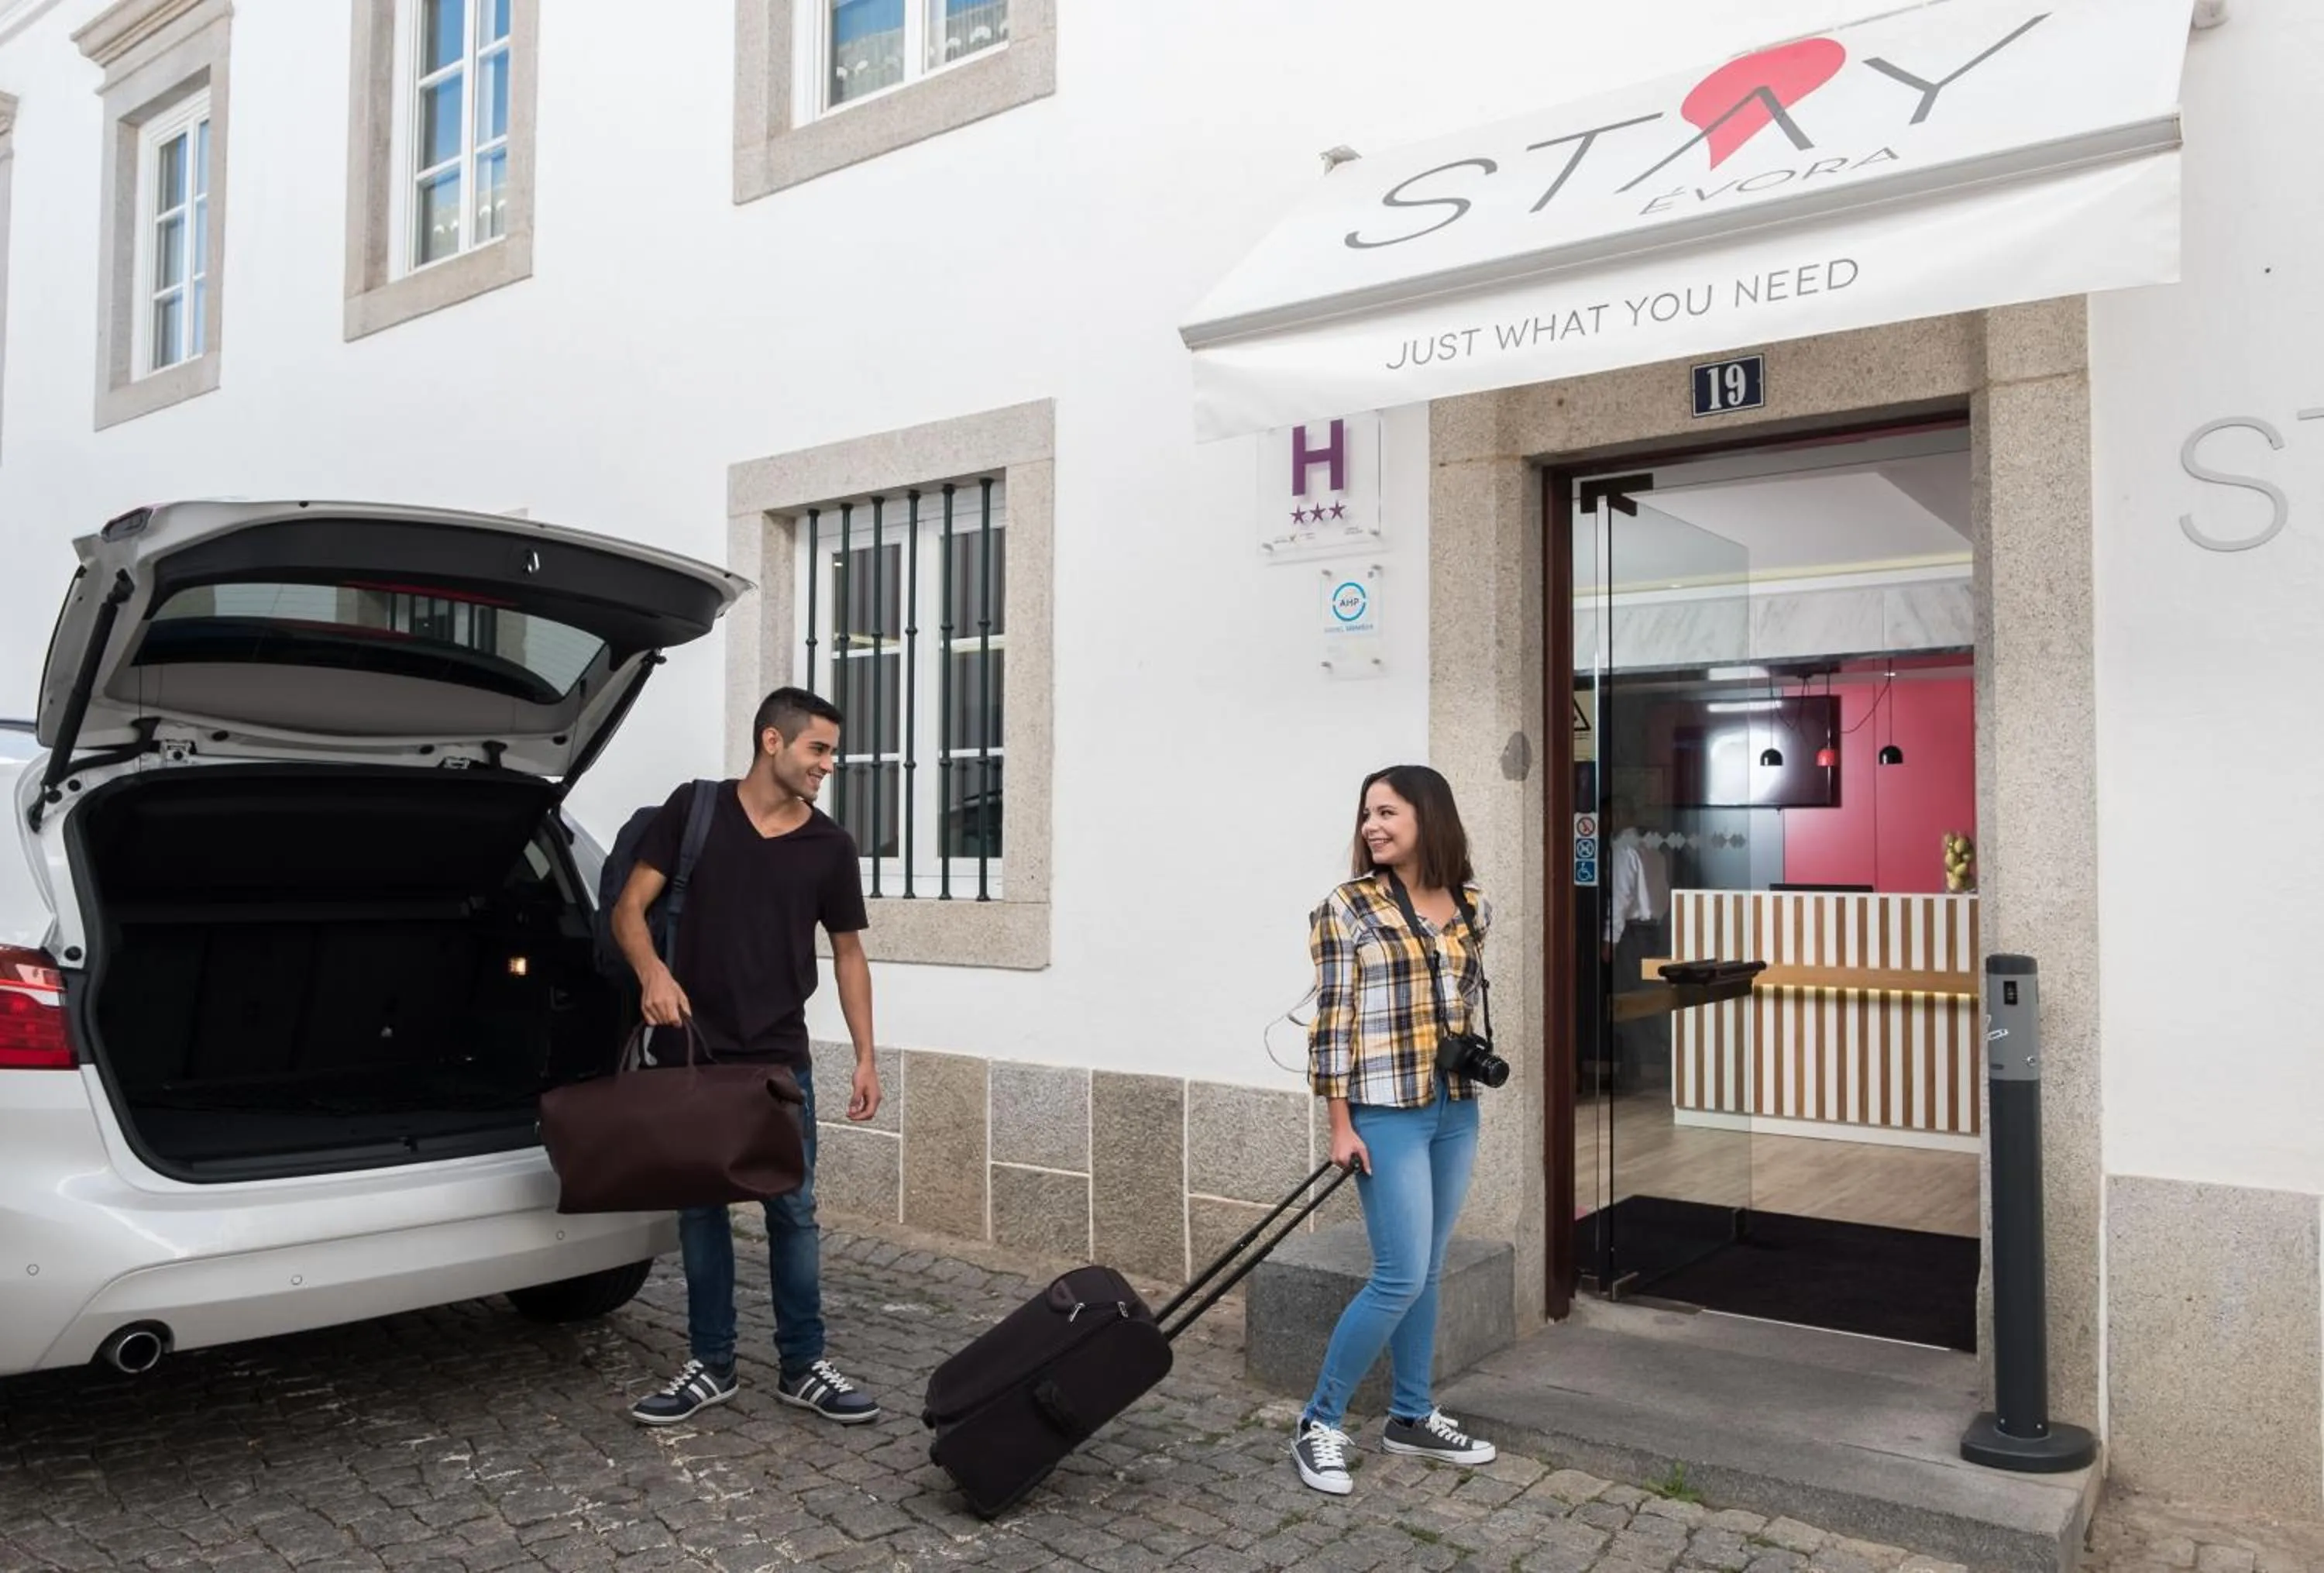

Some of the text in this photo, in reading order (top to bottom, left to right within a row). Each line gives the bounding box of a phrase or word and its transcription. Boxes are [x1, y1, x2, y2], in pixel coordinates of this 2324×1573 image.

[1345, 12, 2050, 250] STAY
[1638, 146, 1899, 215] ÉVORA
[1386, 258, 1859, 370] JUST WHAT YOU NEED
[1707, 363, 1747, 410] 19
[1292, 418, 1344, 496] H
[1339, 597, 1360, 607] AHP
